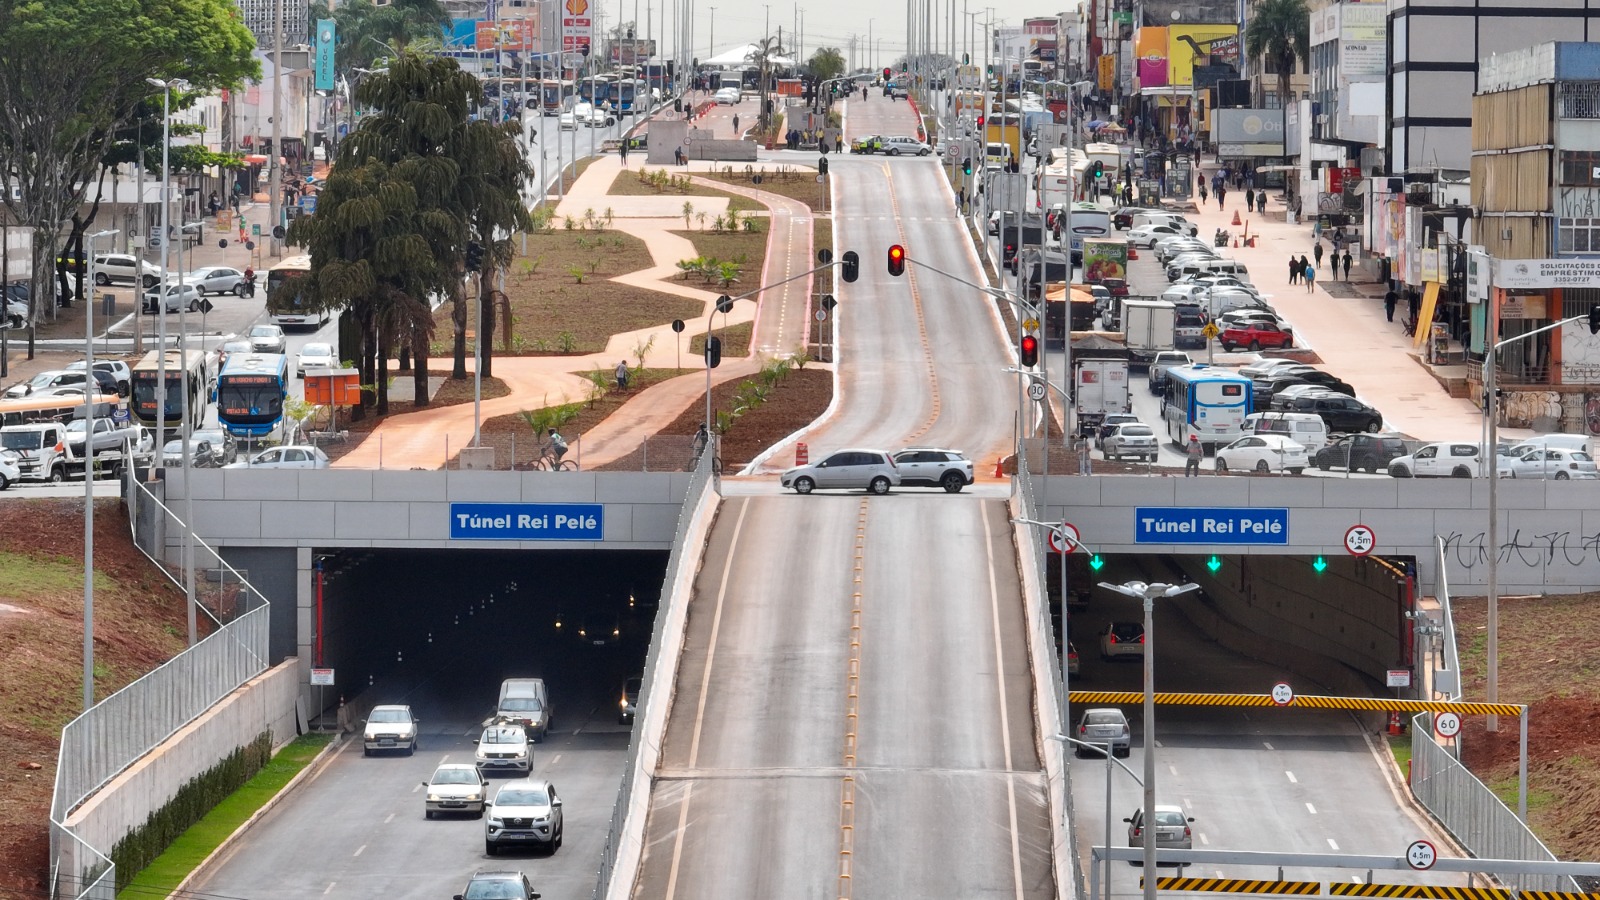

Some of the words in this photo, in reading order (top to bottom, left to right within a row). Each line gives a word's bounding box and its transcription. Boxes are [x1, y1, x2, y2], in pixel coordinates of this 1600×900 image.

[1540, 262, 1595, 270] SOLICITAÇÕES
[457, 513, 511, 529] Túnel
[517, 514, 548, 529] Rei
[555, 514, 597, 530] Pelé
[1142, 517, 1196, 533] Túnel
[1203, 518, 1234, 533] Rei
[1240, 518, 1282, 534] Pelé
[1349, 536, 1371, 545] 4,5m
[1441, 719, 1456, 729] 60
[1412, 851, 1431, 859] 4,5m
